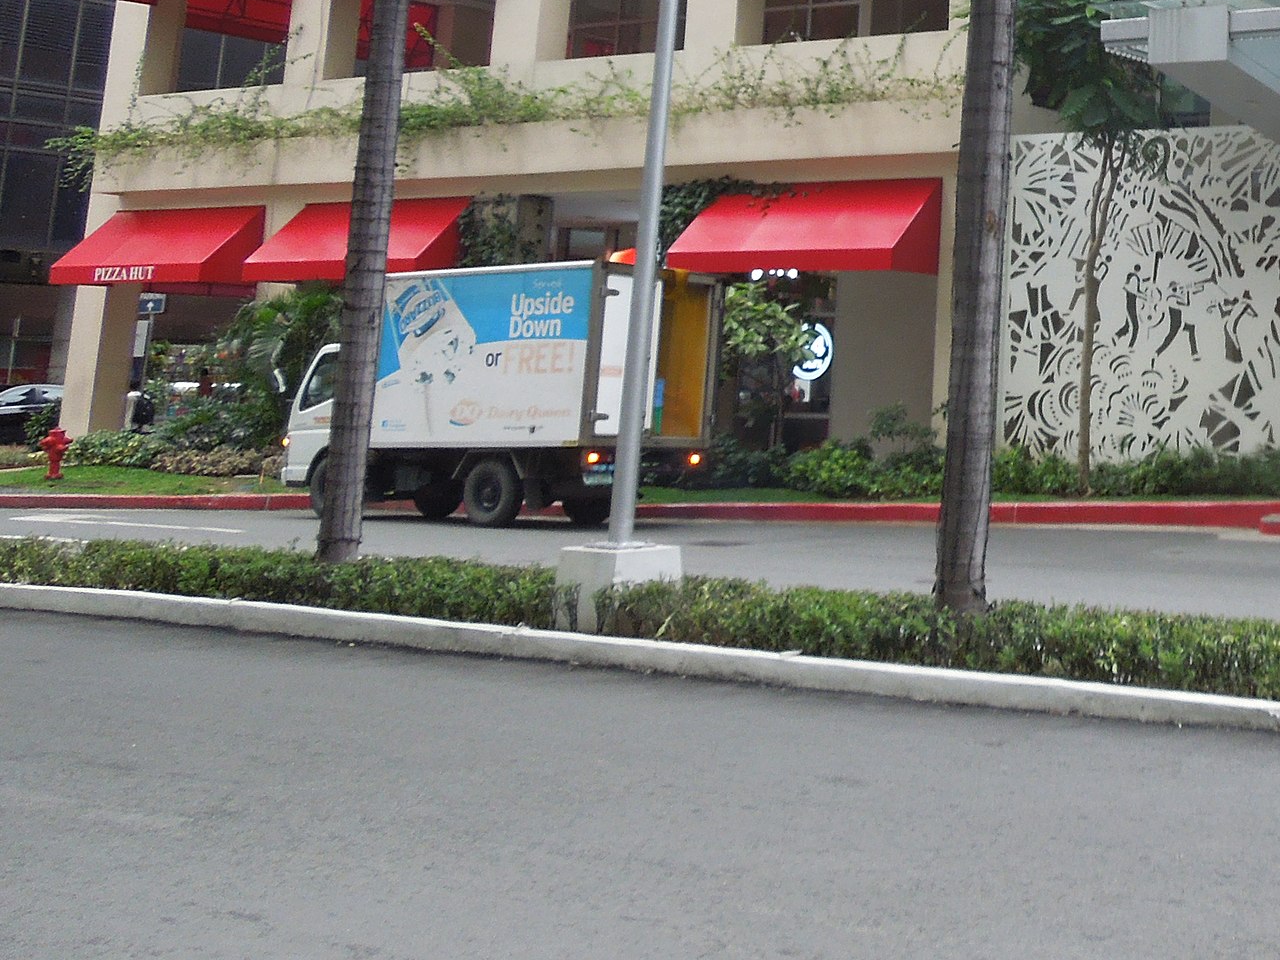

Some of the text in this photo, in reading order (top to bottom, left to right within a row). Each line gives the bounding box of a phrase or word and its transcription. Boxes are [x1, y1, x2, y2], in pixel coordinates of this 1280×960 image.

[94, 266, 154, 281] PIZZA HUT
[511, 292, 575, 319] Upside
[509, 316, 562, 338] Down
[485, 343, 576, 375] or FREE!
